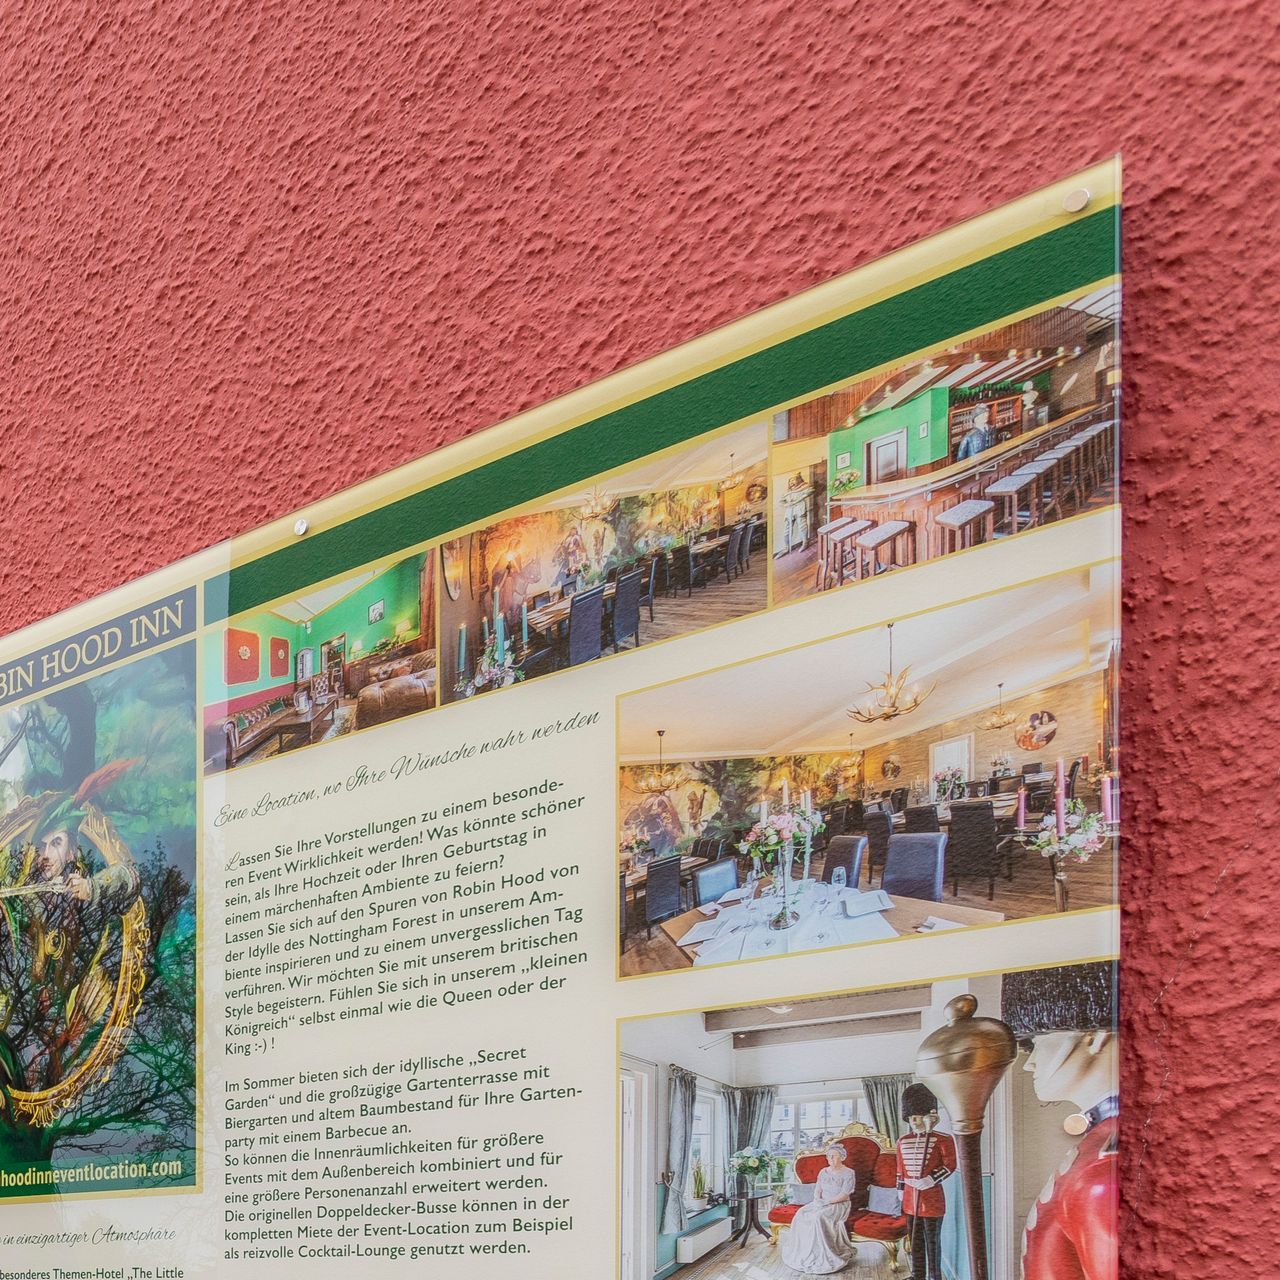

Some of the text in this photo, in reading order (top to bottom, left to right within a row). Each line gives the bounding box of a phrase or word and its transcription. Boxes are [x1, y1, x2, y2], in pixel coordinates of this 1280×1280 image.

[40, 626, 122, 683] HOOD
[129, 599, 184, 648] INN
[212, 710, 601, 829] Eine Location, wo Ihre Wünsche wahr werden
[224, 778, 563, 871] Lassen Sie Ihre Vorstellungen zu einem besonde-
[224, 854, 504, 925] einem märchenhaften Ambiente zu feiern?
[224, 890, 563, 962] der Idylle des Nottingham Forest in unserem Am-
[224, 1003, 253, 1020] Style
[257, 995, 324, 1014] begeistern.
[329, 985, 372, 1002] Fühlen
[377, 980, 397, 994] Sie
[402, 974, 428, 990] sich
[433, 972, 445, 985] in
[451, 963, 515, 982] unserem
[279, 1090, 301, 1105] und
[305, 1089, 324, 1102] die
[328, 1082, 401, 1103] großzügige
[406, 1071, 517, 1091] Gartenterrasse
[523, 1064, 550, 1079] mit
[224, 1131, 543, 1166] So können die Innenräumlichkeiten für größere
[224, 1194, 570, 1224] Die originellen Doppeldecker-Busse können in der
[2, 1232, 15, 1247] in
[16, 1231, 89, 1250] einzigartiger
[91, 1224, 177, 1248] Atmosphäre
[224, 1239, 530, 1259] als reizvolle Cocktail-Lounge genutzt werden.
[0, 1268, 50, 1280] besonderes
[52, 1267, 123, 1279] Themen-Hotel
[156, 1266, 183, 1278] Little
